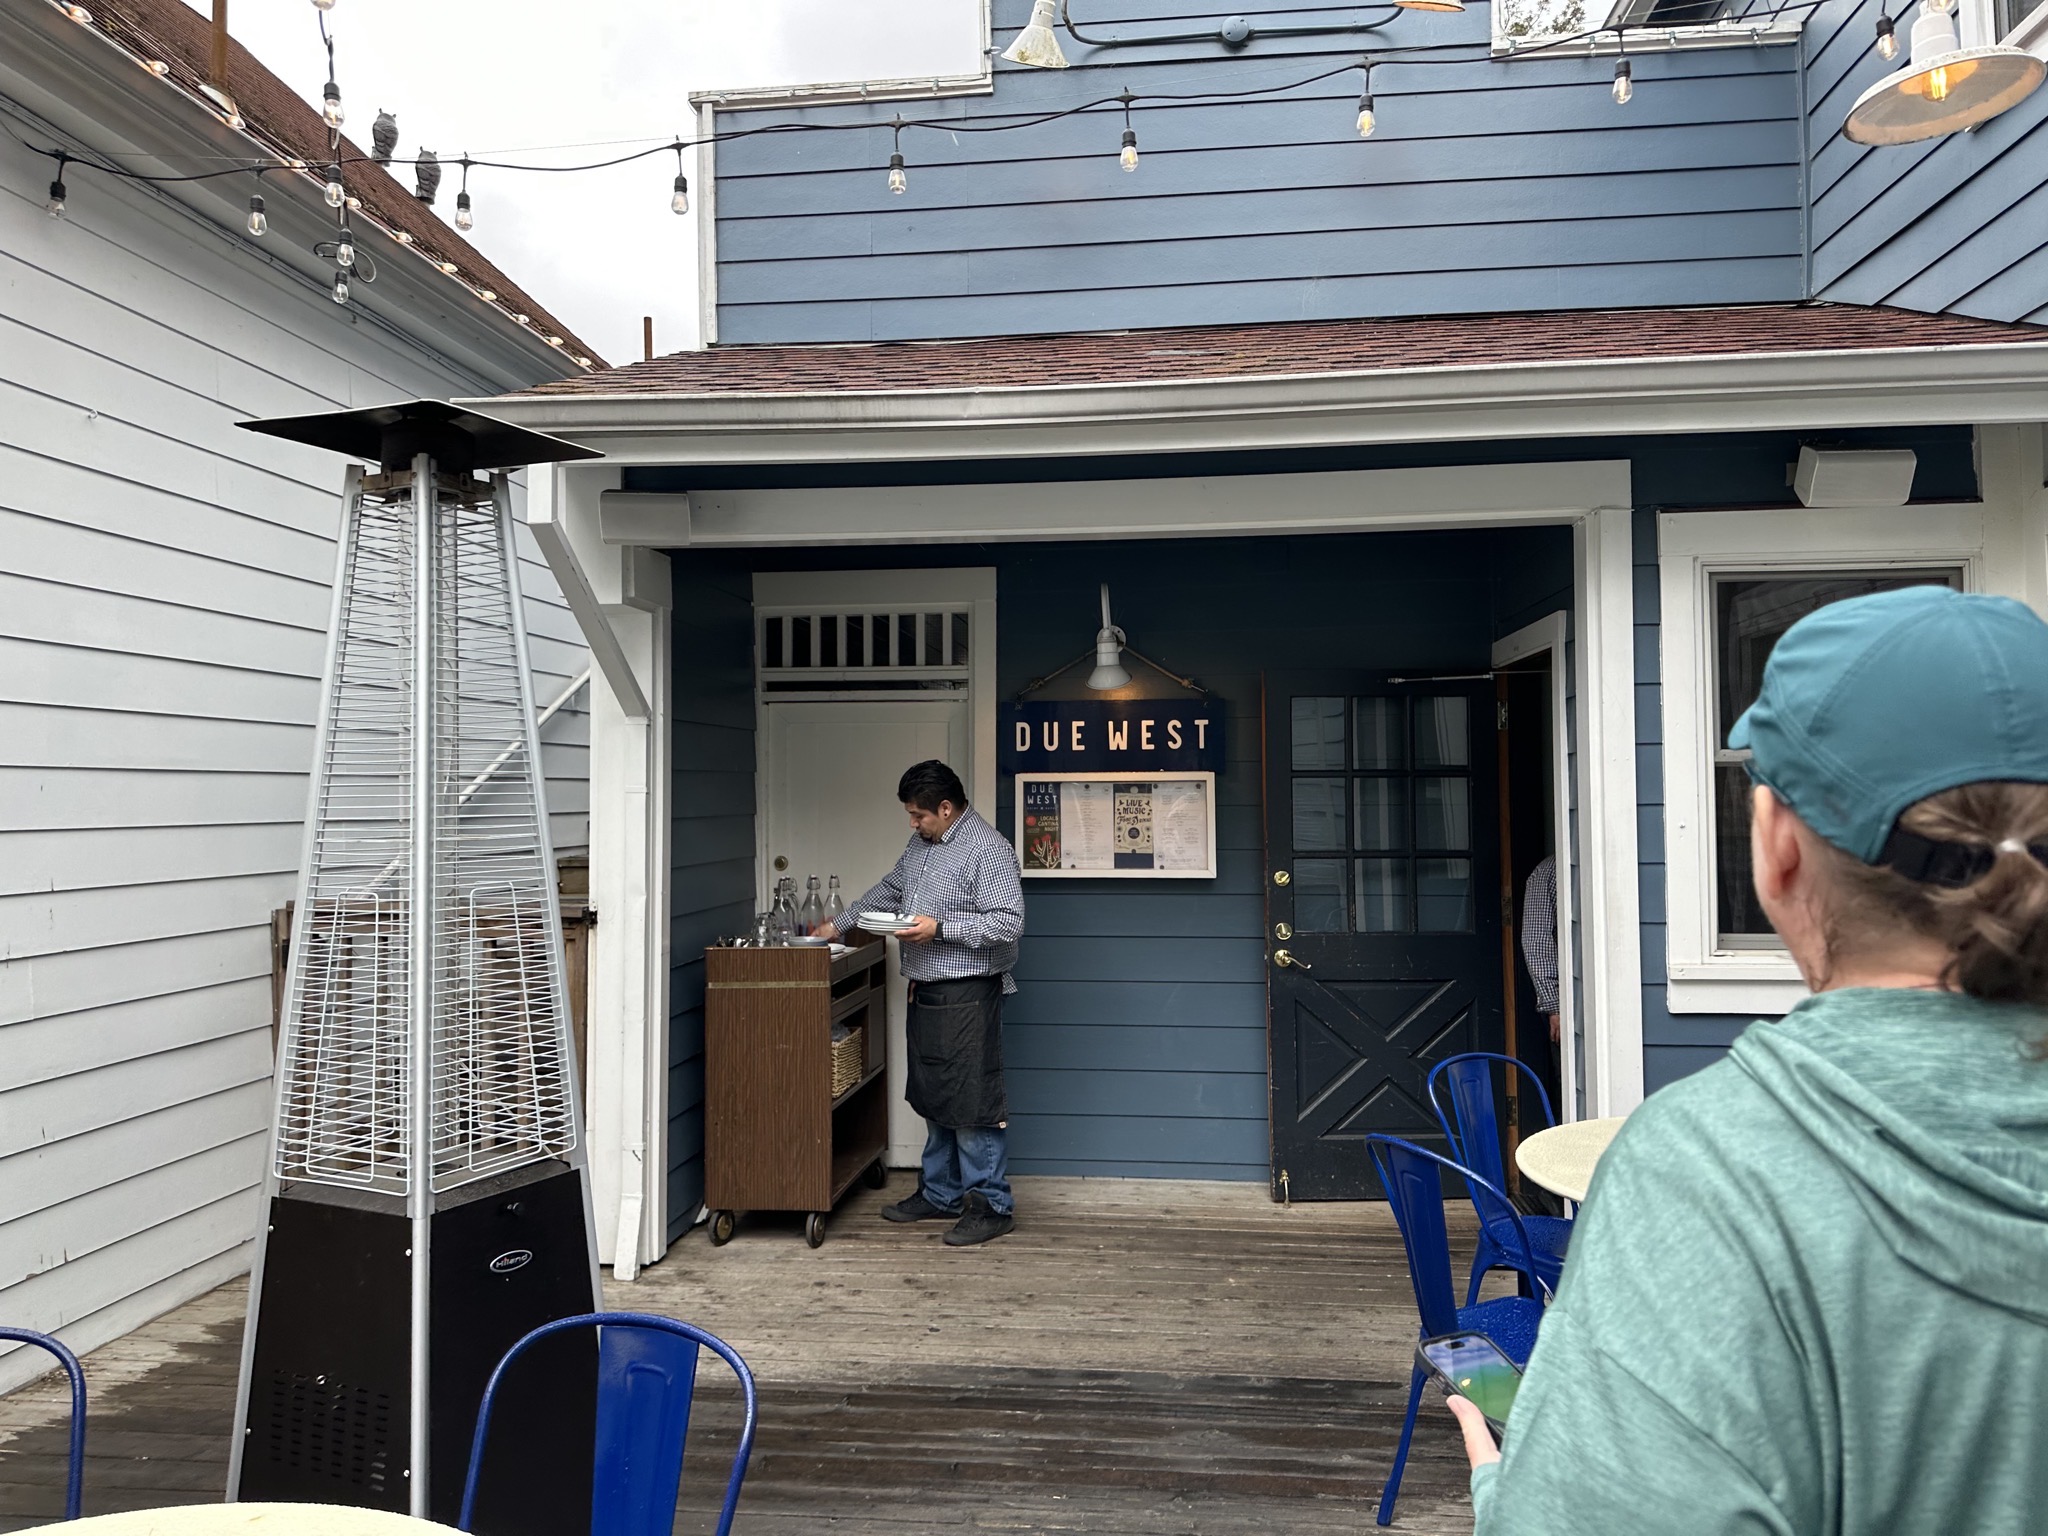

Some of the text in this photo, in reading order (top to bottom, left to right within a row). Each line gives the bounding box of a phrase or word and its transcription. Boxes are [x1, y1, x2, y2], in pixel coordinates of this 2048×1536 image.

[1015, 719, 1210, 752] DUE WEST
[1031, 784, 1053, 793] DUE
[1027, 795, 1058, 804] WEST
[1126, 799, 1143, 807] LIVE
[1122, 807, 1146, 815] MUSIC
